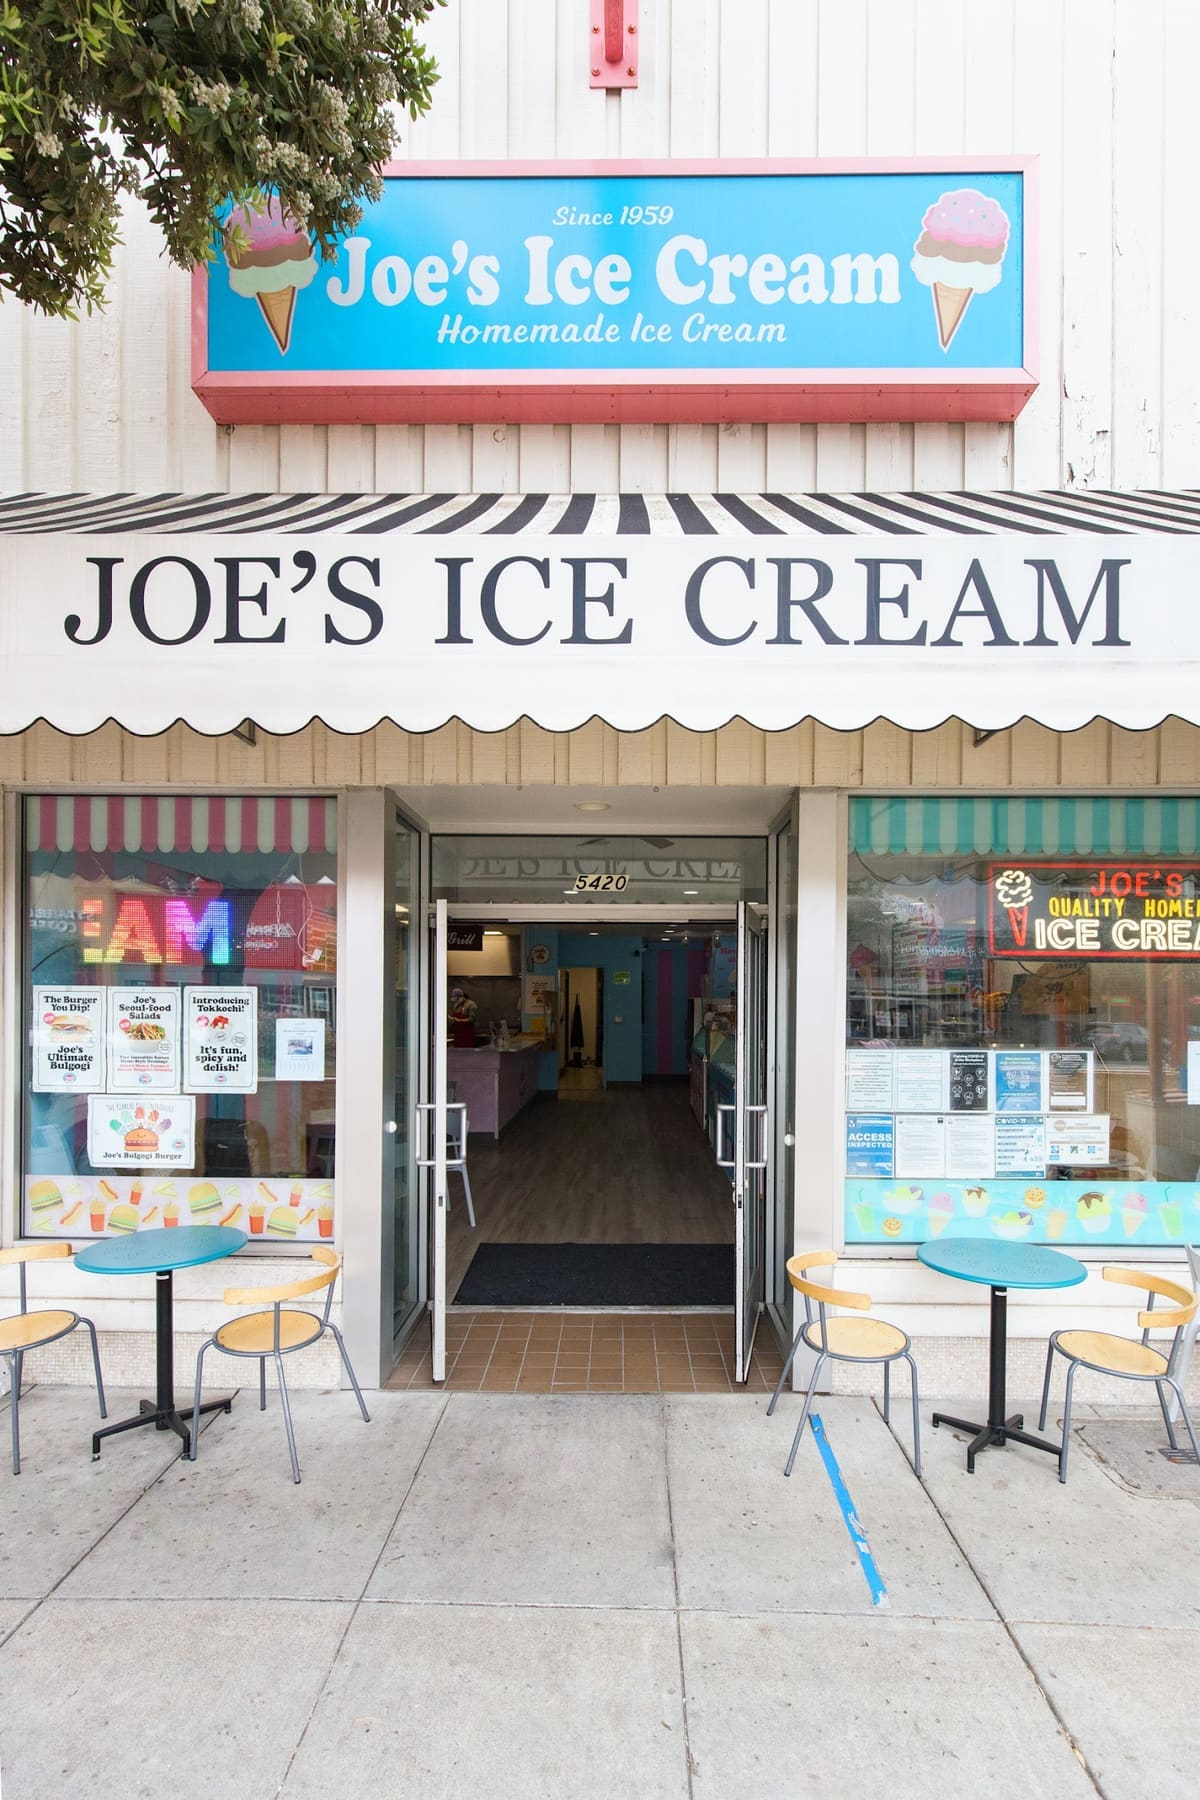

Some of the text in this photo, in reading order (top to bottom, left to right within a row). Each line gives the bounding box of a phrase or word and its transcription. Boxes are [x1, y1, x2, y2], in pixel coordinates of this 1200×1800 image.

[553, 205, 674, 226] Since 1959
[326, 235, 902, 307] Joe's Ice Cream
[437, 312, 789, 345] Homemade Ice Cream
[64, 550, 1132, 647] JOE'S ICE CREAM
[576, 875, 626, 890] 5420
[1090, 870, 1184, 897] JOE'S
[1049, 897, 1200, 918] QUALITY HOME
[1035, 918, 1200, 951] ICE CRE
[63, 996, 98, 1005] Burger
[133, 996, 156, 1004] Joe's
[193, 997, 249, 1006] Introducing
[69, 1004, 90, 1013] Dip!
[119, 1004, 171, 1012] Seoul-food
[129, 1012, 161, 1020] Salads
[57, 1046, 83, 1054] Joe's
[200, 1046, 243, 1056] It's fun,
[48, 1054, 93, 1062] Ultimate
[195, 1054, 247, 1063] spicy and
[50, 1062, 91, 1071] Bulgogi
[203, 1063, 239, 1071] delish!
[848, 1133, 892, 1141] ACCESS
[123, 1152, 153, 1160] Bulgogi
[155, 1152, 183, 1160] Burger
